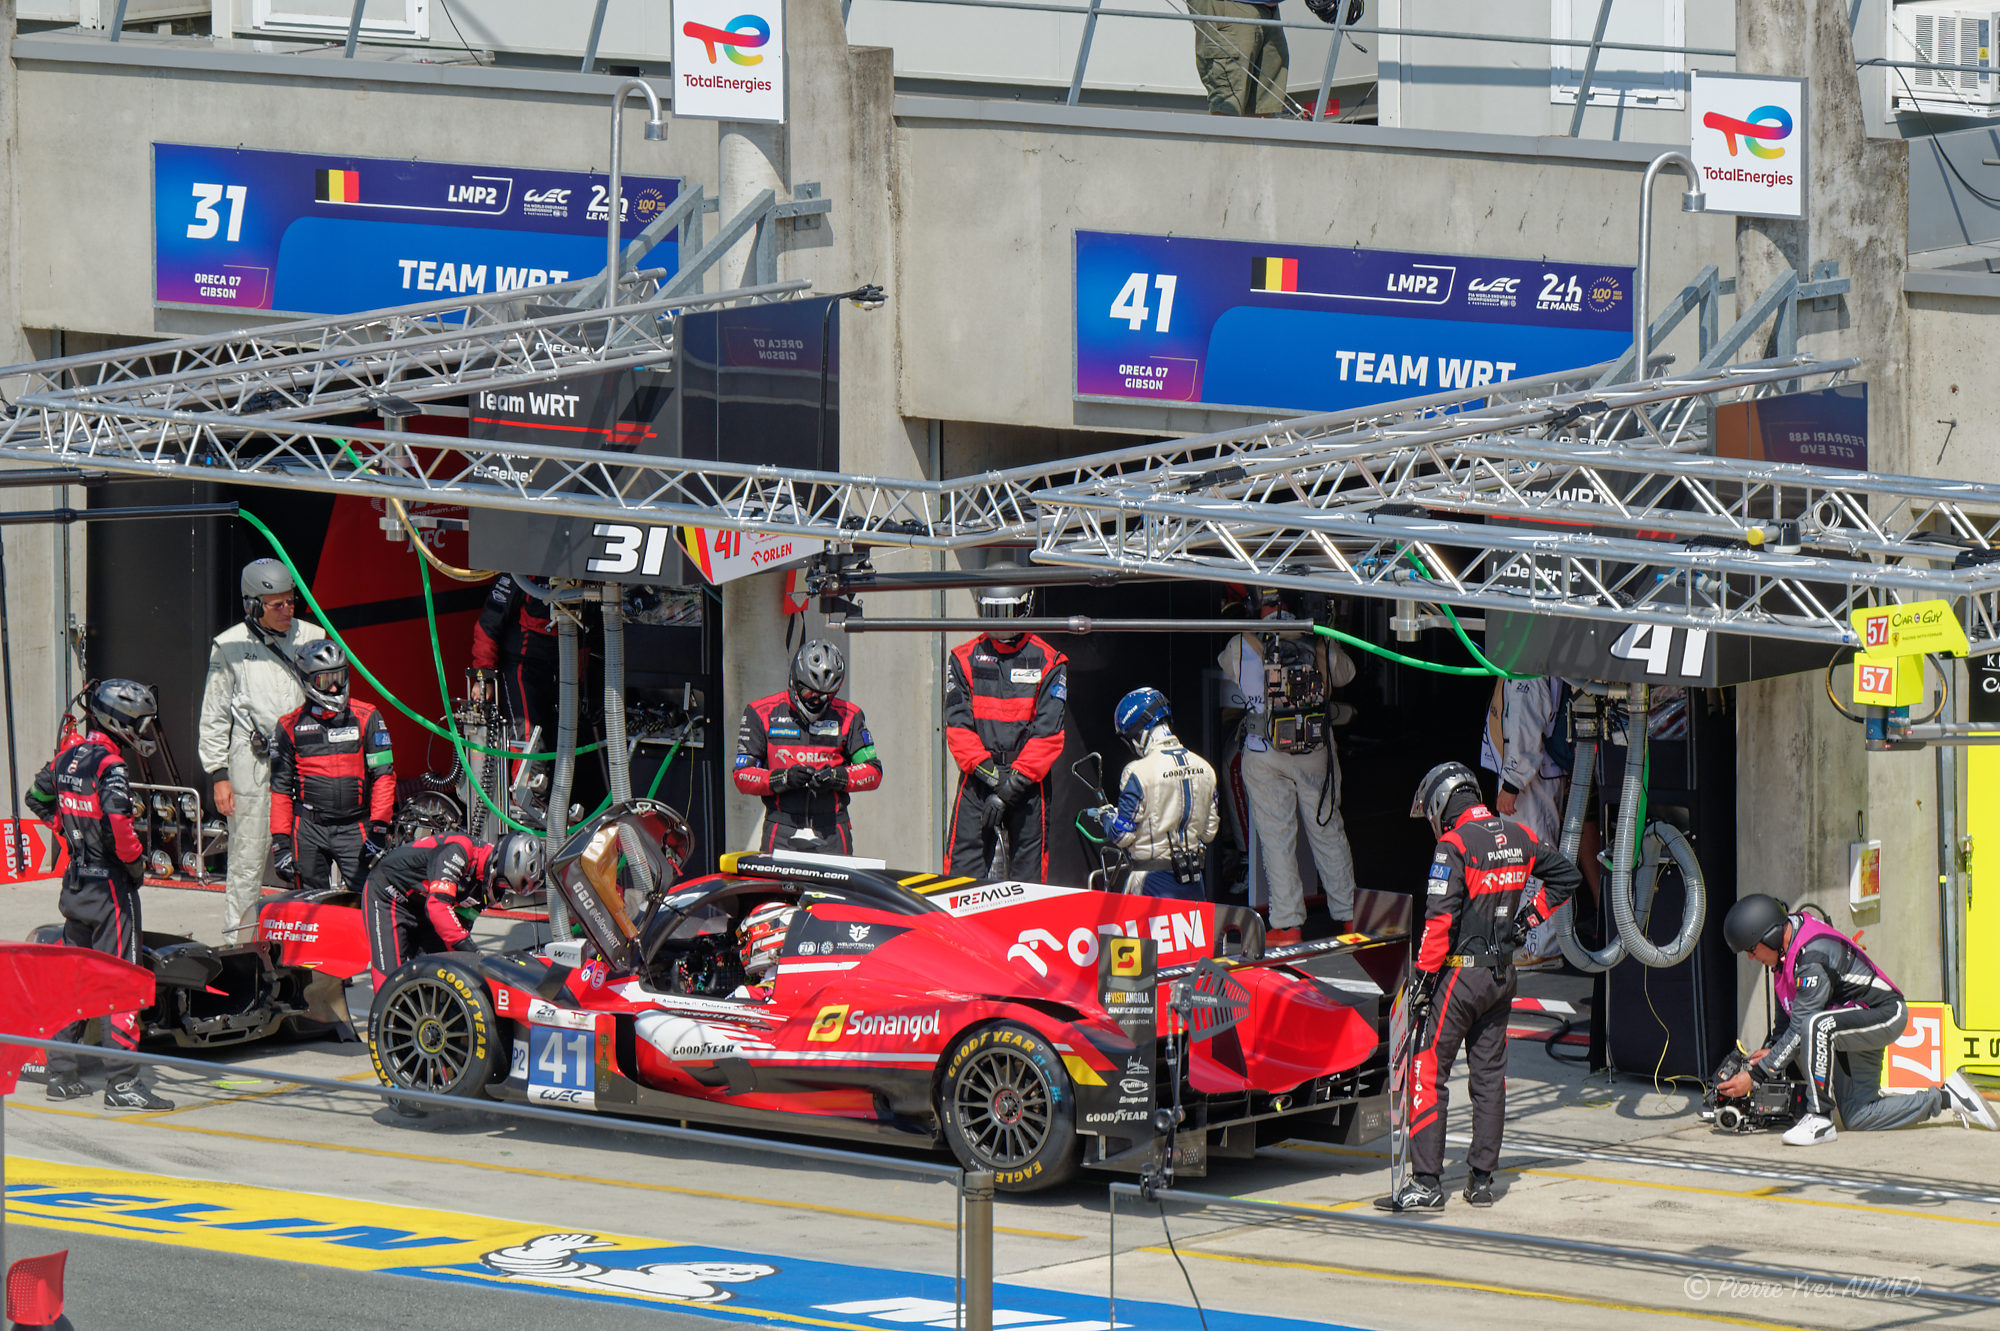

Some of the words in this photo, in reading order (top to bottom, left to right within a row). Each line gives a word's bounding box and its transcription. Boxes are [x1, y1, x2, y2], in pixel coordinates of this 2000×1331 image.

[683, 74, 772, 93] TotalEnergies
[1703, 166, 1793, 188] TotalEnergies
[447, 184, 498, 205] LMP2
[186, 182, 247, 242] 31
[586, 211, 598, 220] LE
[194, 273, 227, 286] ORECA
[229, 276, 242, 287] 07
[398, 259, 488, 294] TEAM
[1386, 273, 1439, 295] LMP2
[200, 286, 237, 299] GIBSON
[1109, 272, 1177, 333] 41
[1592, 288, 1611, 300] 100
[1536, 301, 1549, 310] LE
[1550, 302, 1580, 312] MANS
[1118, 364, 1153, 377] ORECA
[1155, 367, 1169, 378] 07
[1335, 350, 1429, 387] TEAM
[1125, 377, 1163, 391] GIBSON
[478, 390, 525, 414] Team
[528, 391, 580, 418] WRT
[586, 522, 669, 576] 31
[714, 529, 741, 560] 41
[763, 542, 792, 563] ORLEN
[1866, 617, 1888, 645] 57
[1610, 623, 1708, 677] 41
[1862, 666, 1890, 692] 57
[1162, 766, 1205, 779] GOODYEAR
[3, 822, 19, 880] READY
[21, 832, 33, 868] GET
[1487, 847, 1523, 862] PLATINUM
[959, 884, 1024, 907] REMUS
[263, 919, 294, 930] Drive
[294, 920, 319, 932] Fast
[589, 906, 621, 949] @followWRT
[265, 930, 283, 940] Act
[283, 930, 319, 943] Faster
[553, 949, 577, 960] WRT
[799, 943, 815, 954] FIA
[1806, 976, 1818, 988] 75
[498, 989, 509, 1005] B
[1104, 991, 1150, 1004] #VISITANGOLA
[437, 968, 486, 1060] GOODYEAR
[1107, 1006, 1154, 1014] SKECHERS
[846, 1010, 940, 1042] Sonangol
[538, 1031, 587, 1087] 41
[673, 1042, 735, 1056] GOODYEAR
[948, 1031, 1035, 1078] GOODYEAR
[1814, 1030, 1828, 1078] NASCAR
[1894, 1017, 1941, 1083] 57
[540, 1089, 583, 1104] WEC
[1086, 1109, 1148, 1124] GOODYEAR
[995, 1159, 1043, 1184] EAGLE
